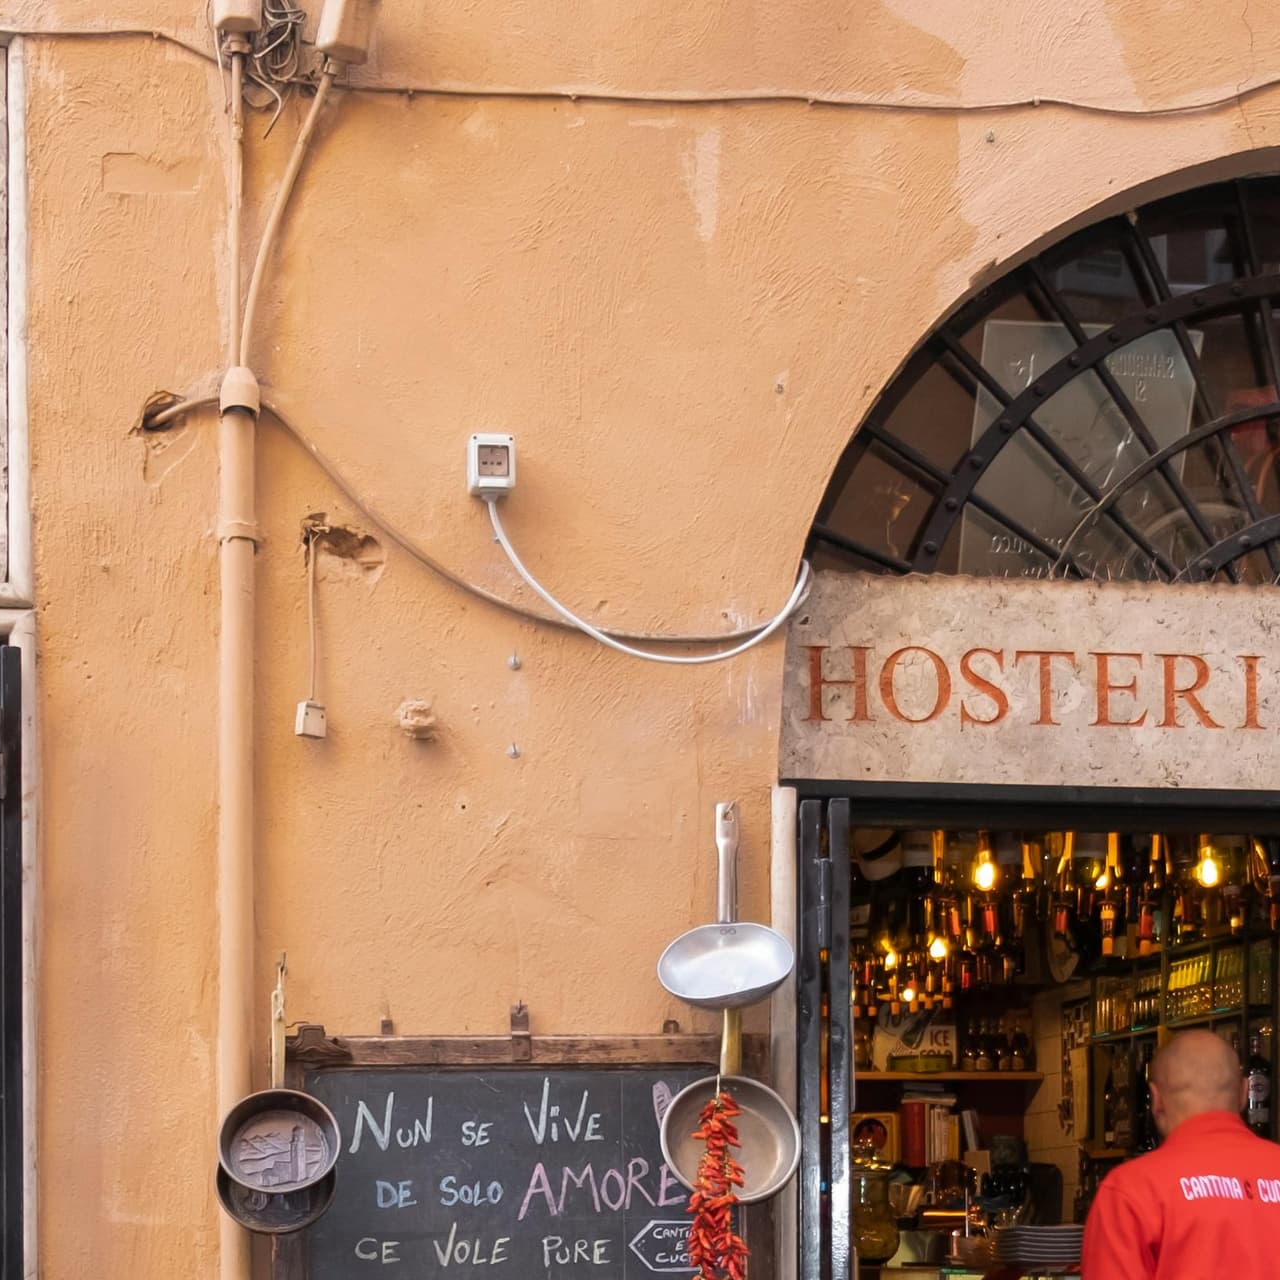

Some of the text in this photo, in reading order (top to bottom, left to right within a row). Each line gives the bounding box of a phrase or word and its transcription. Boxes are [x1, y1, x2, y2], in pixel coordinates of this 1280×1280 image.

[460, 1121, 494, 1147] SE
[375, 1156, 689, 1221] DE SOLO AMORE
[1179, 1174, 1244, 1201] CANTINA
[354, 1222, 613, 1268] CE VOLE PURE
[674, 1240, 686, 1251] E
